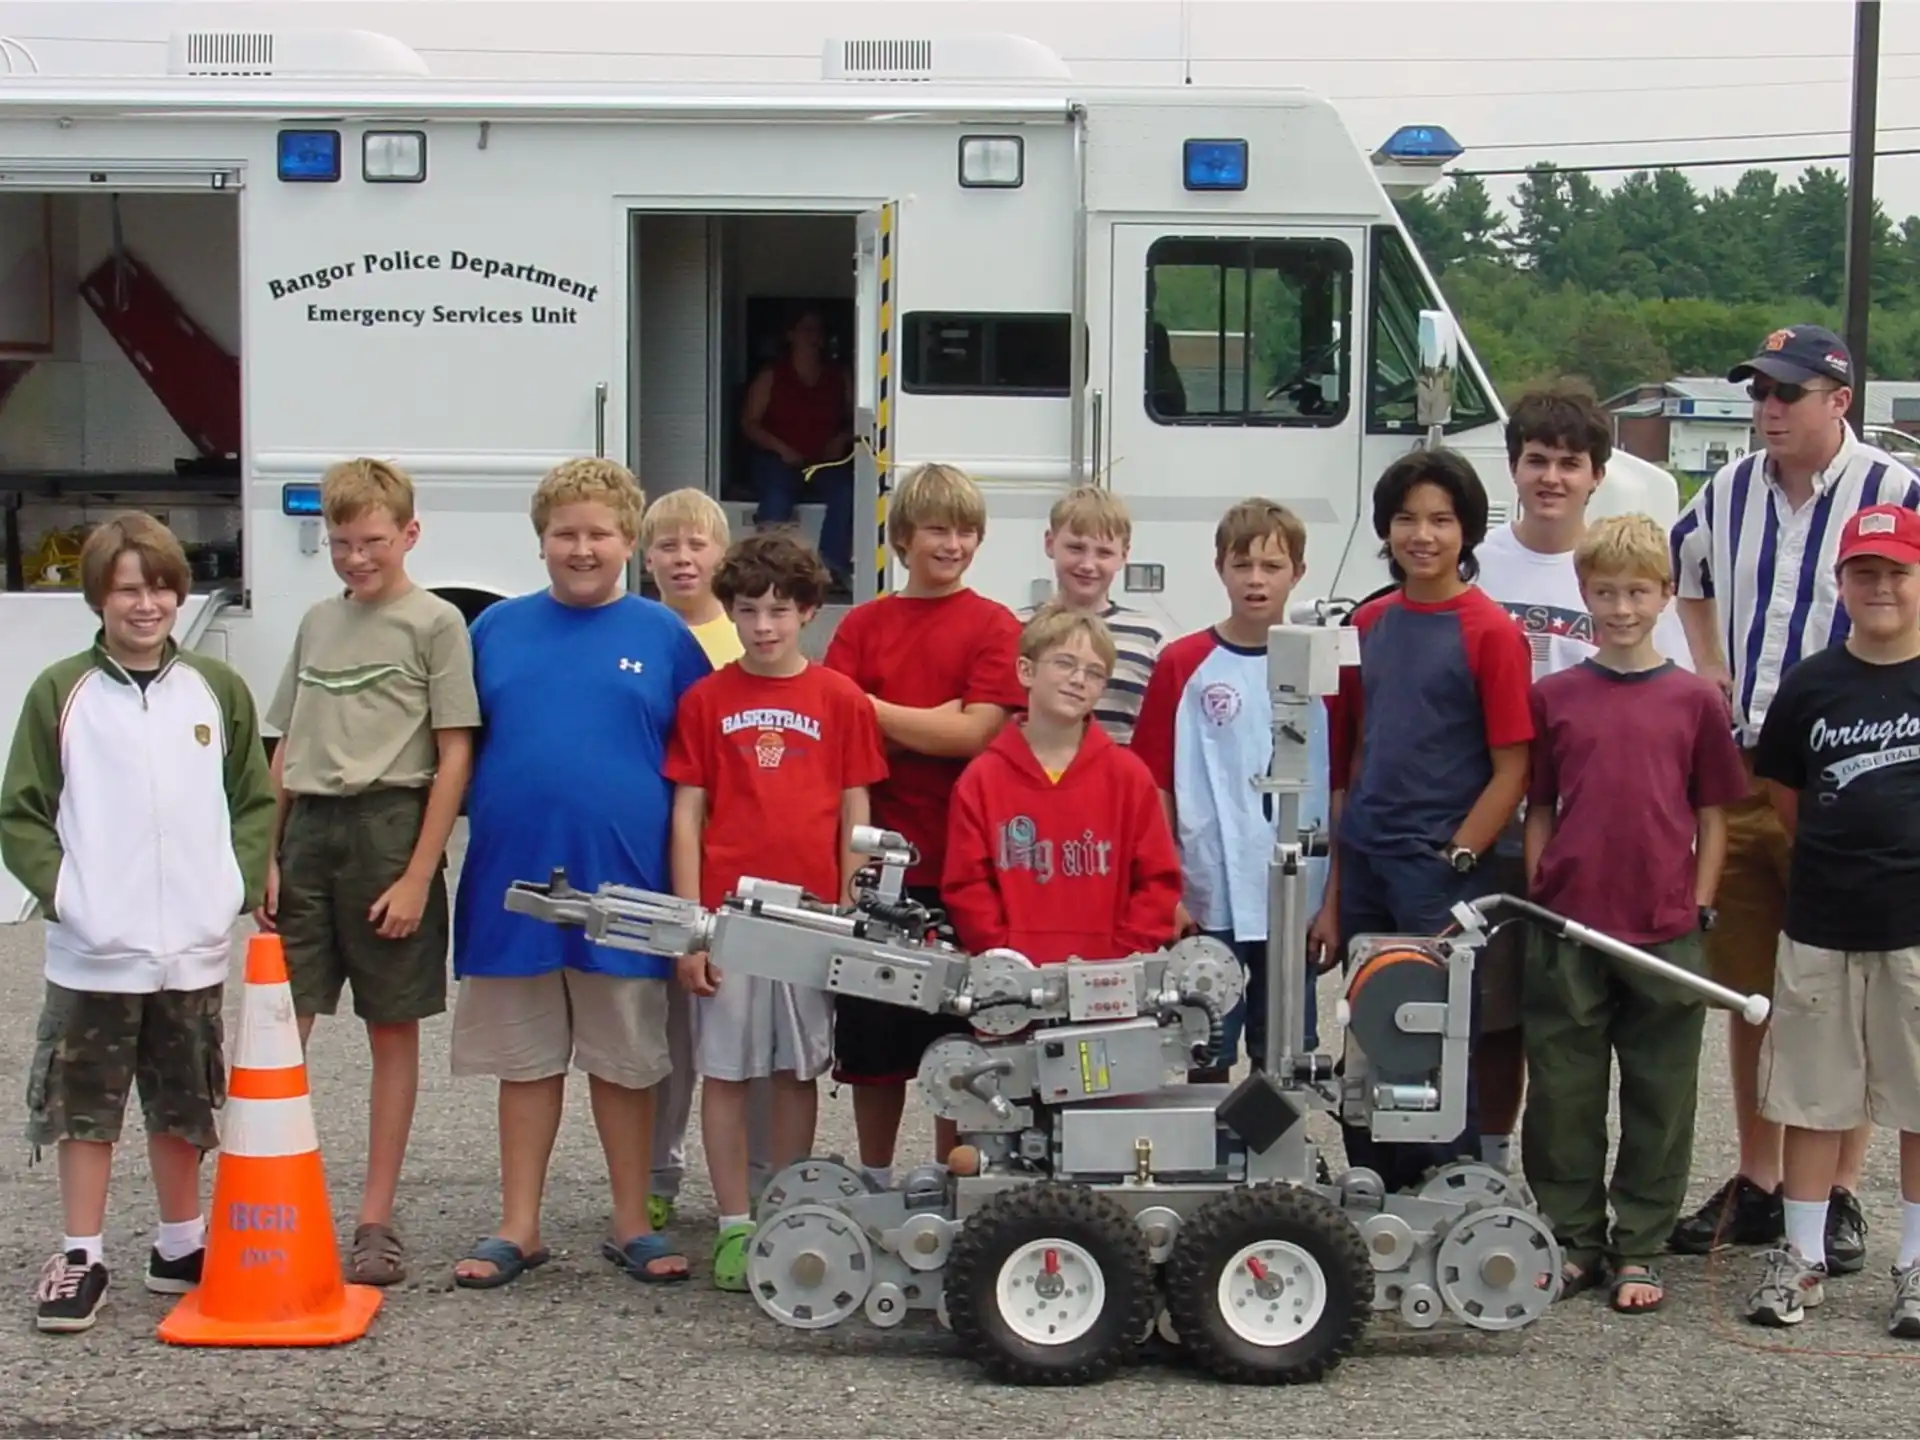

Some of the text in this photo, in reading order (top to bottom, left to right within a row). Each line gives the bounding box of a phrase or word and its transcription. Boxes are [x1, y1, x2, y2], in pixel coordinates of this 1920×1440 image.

[268, 250, 598, 302] Bangor Police Department
[308, 305, 578, 326] Emergency Services Unit
[721, 709, 821, 740] BASKETBALL
[1810, 712, 1920, 752] Orringto
[1842, 747, 1920, 775] BASEBAL
